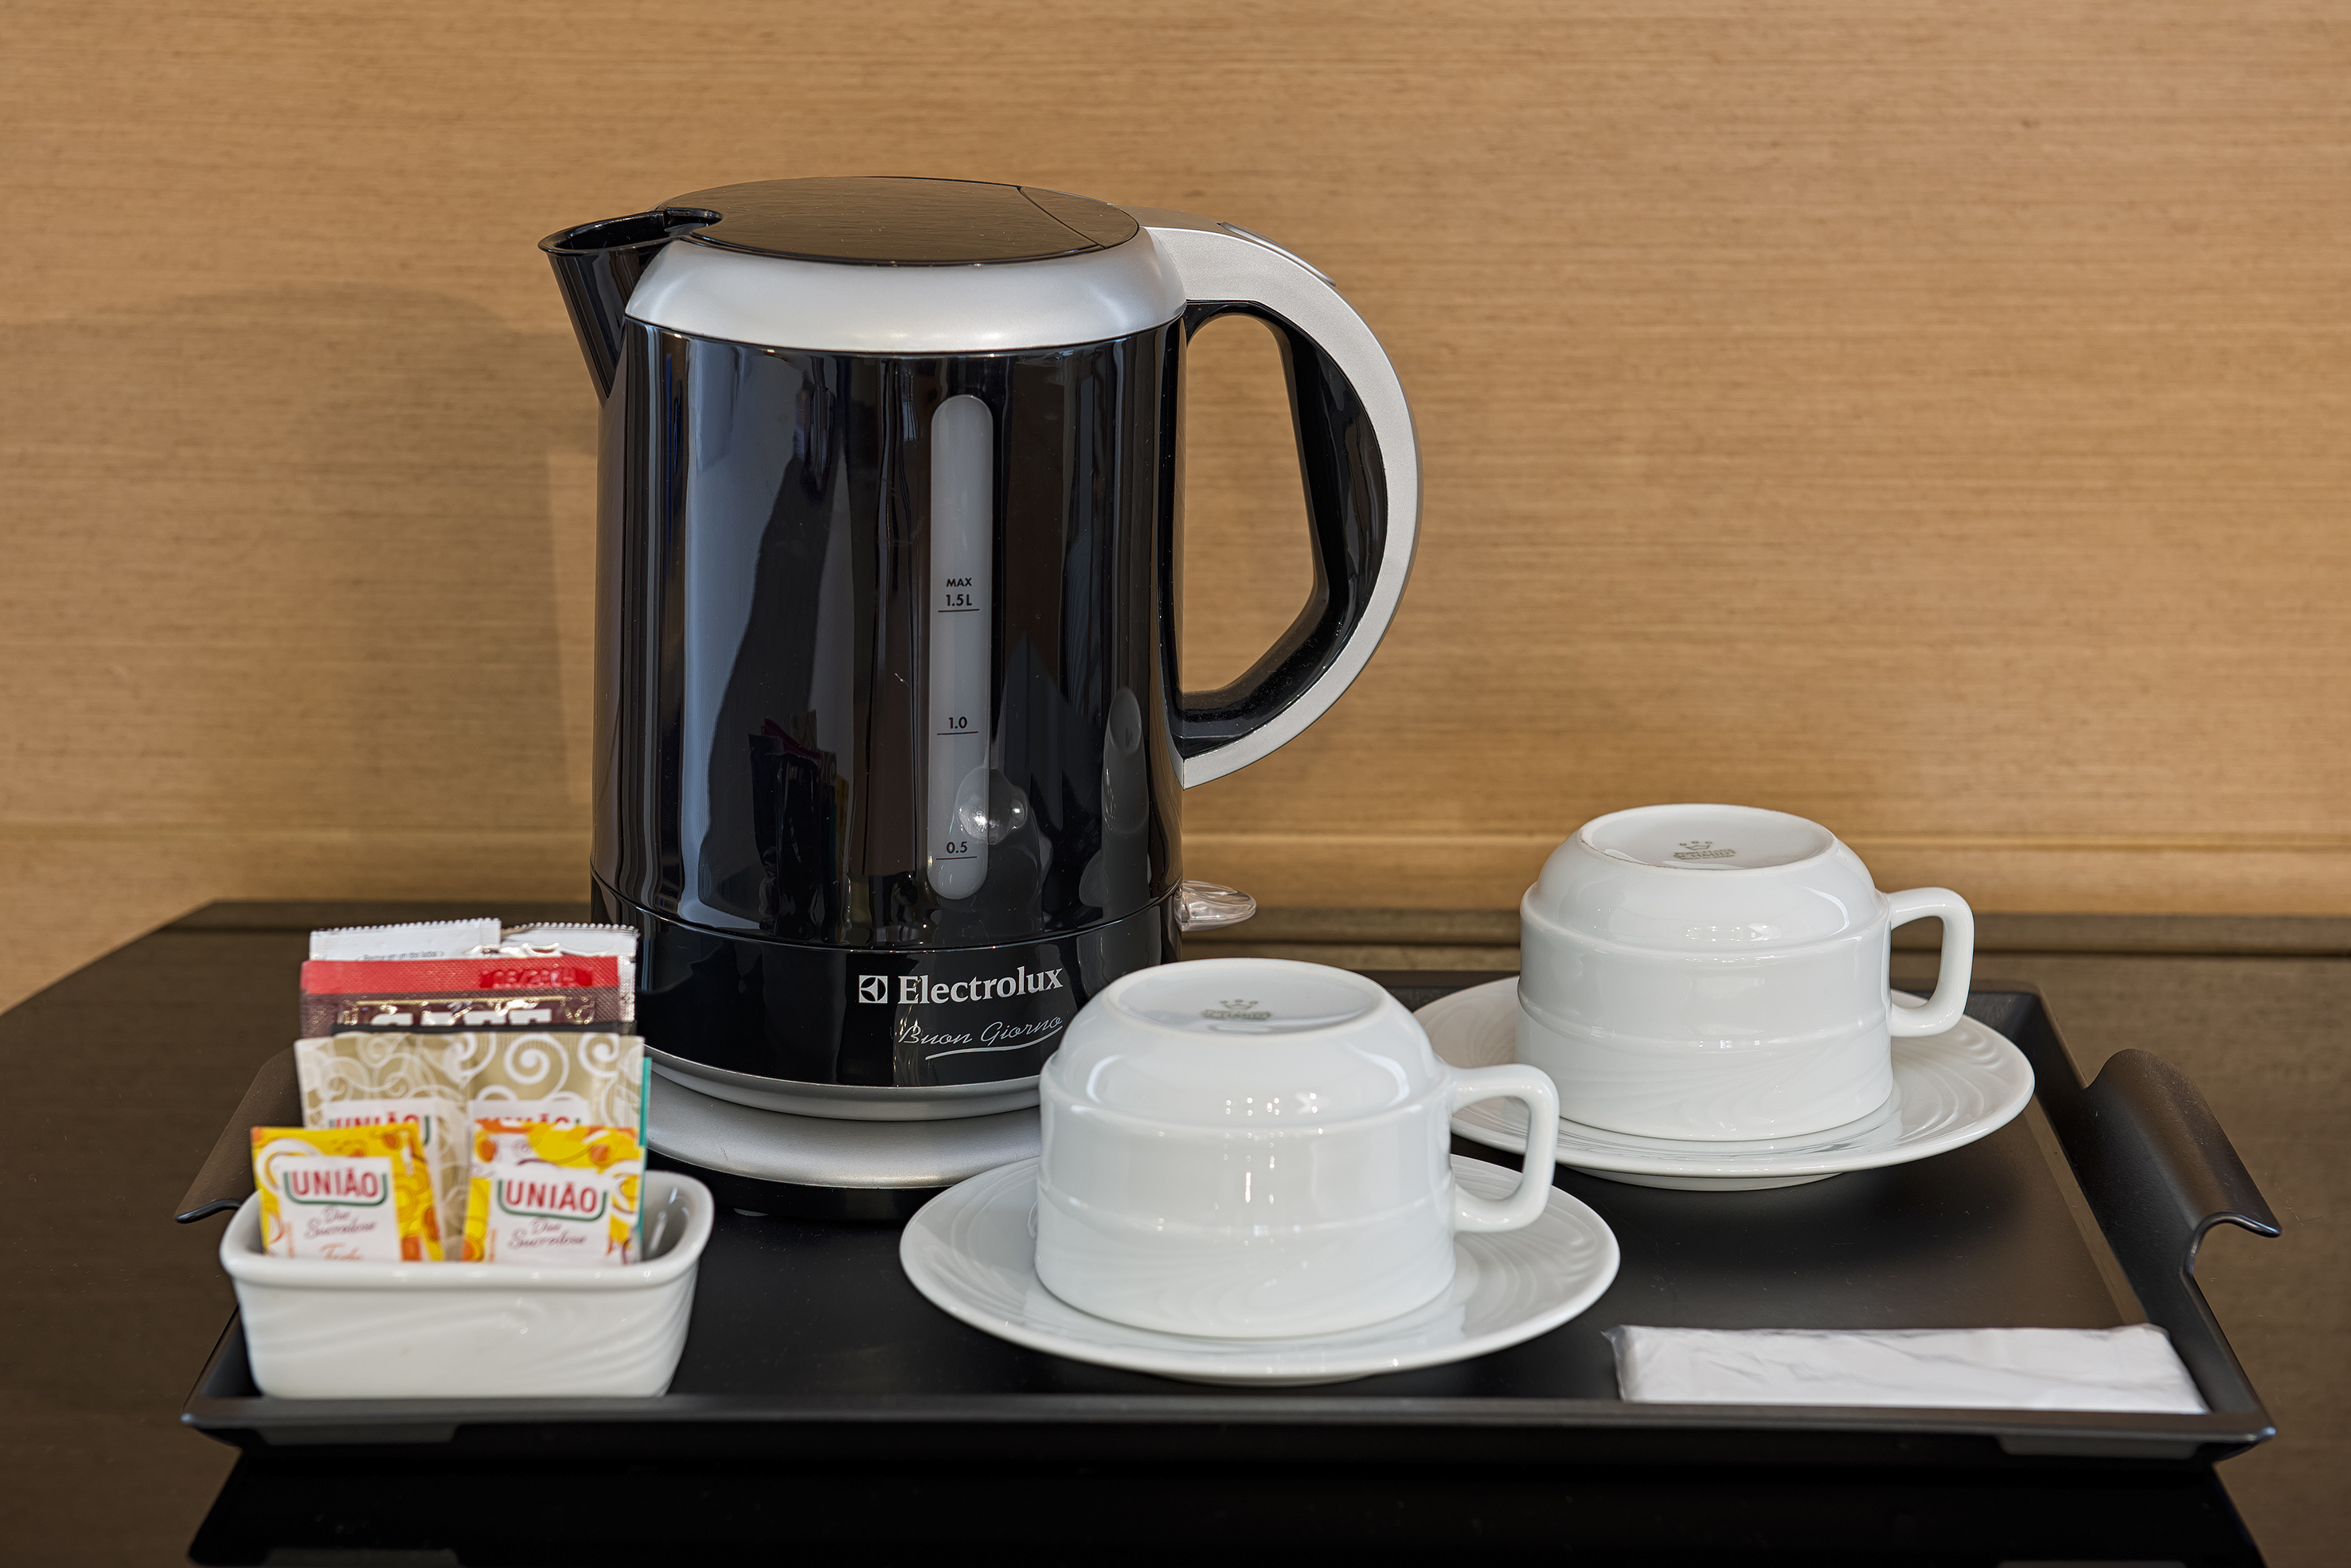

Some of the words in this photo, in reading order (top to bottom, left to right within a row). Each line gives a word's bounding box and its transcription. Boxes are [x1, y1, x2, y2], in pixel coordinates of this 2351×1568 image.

[946, 578, 972, 587] MAX
[948, 716, 968, 729] 1.0
[946, 841, 968, 854] 0.5
[897, 965, 1064, 1004] Electrolux
[898, 1025, 973, 1044] Buon
[980, 1016, 1063, 1047] Giorno
[291, 1167, 378, 1197] UNIÃO
[506, 1180, 597, 1213] UNIÃO
